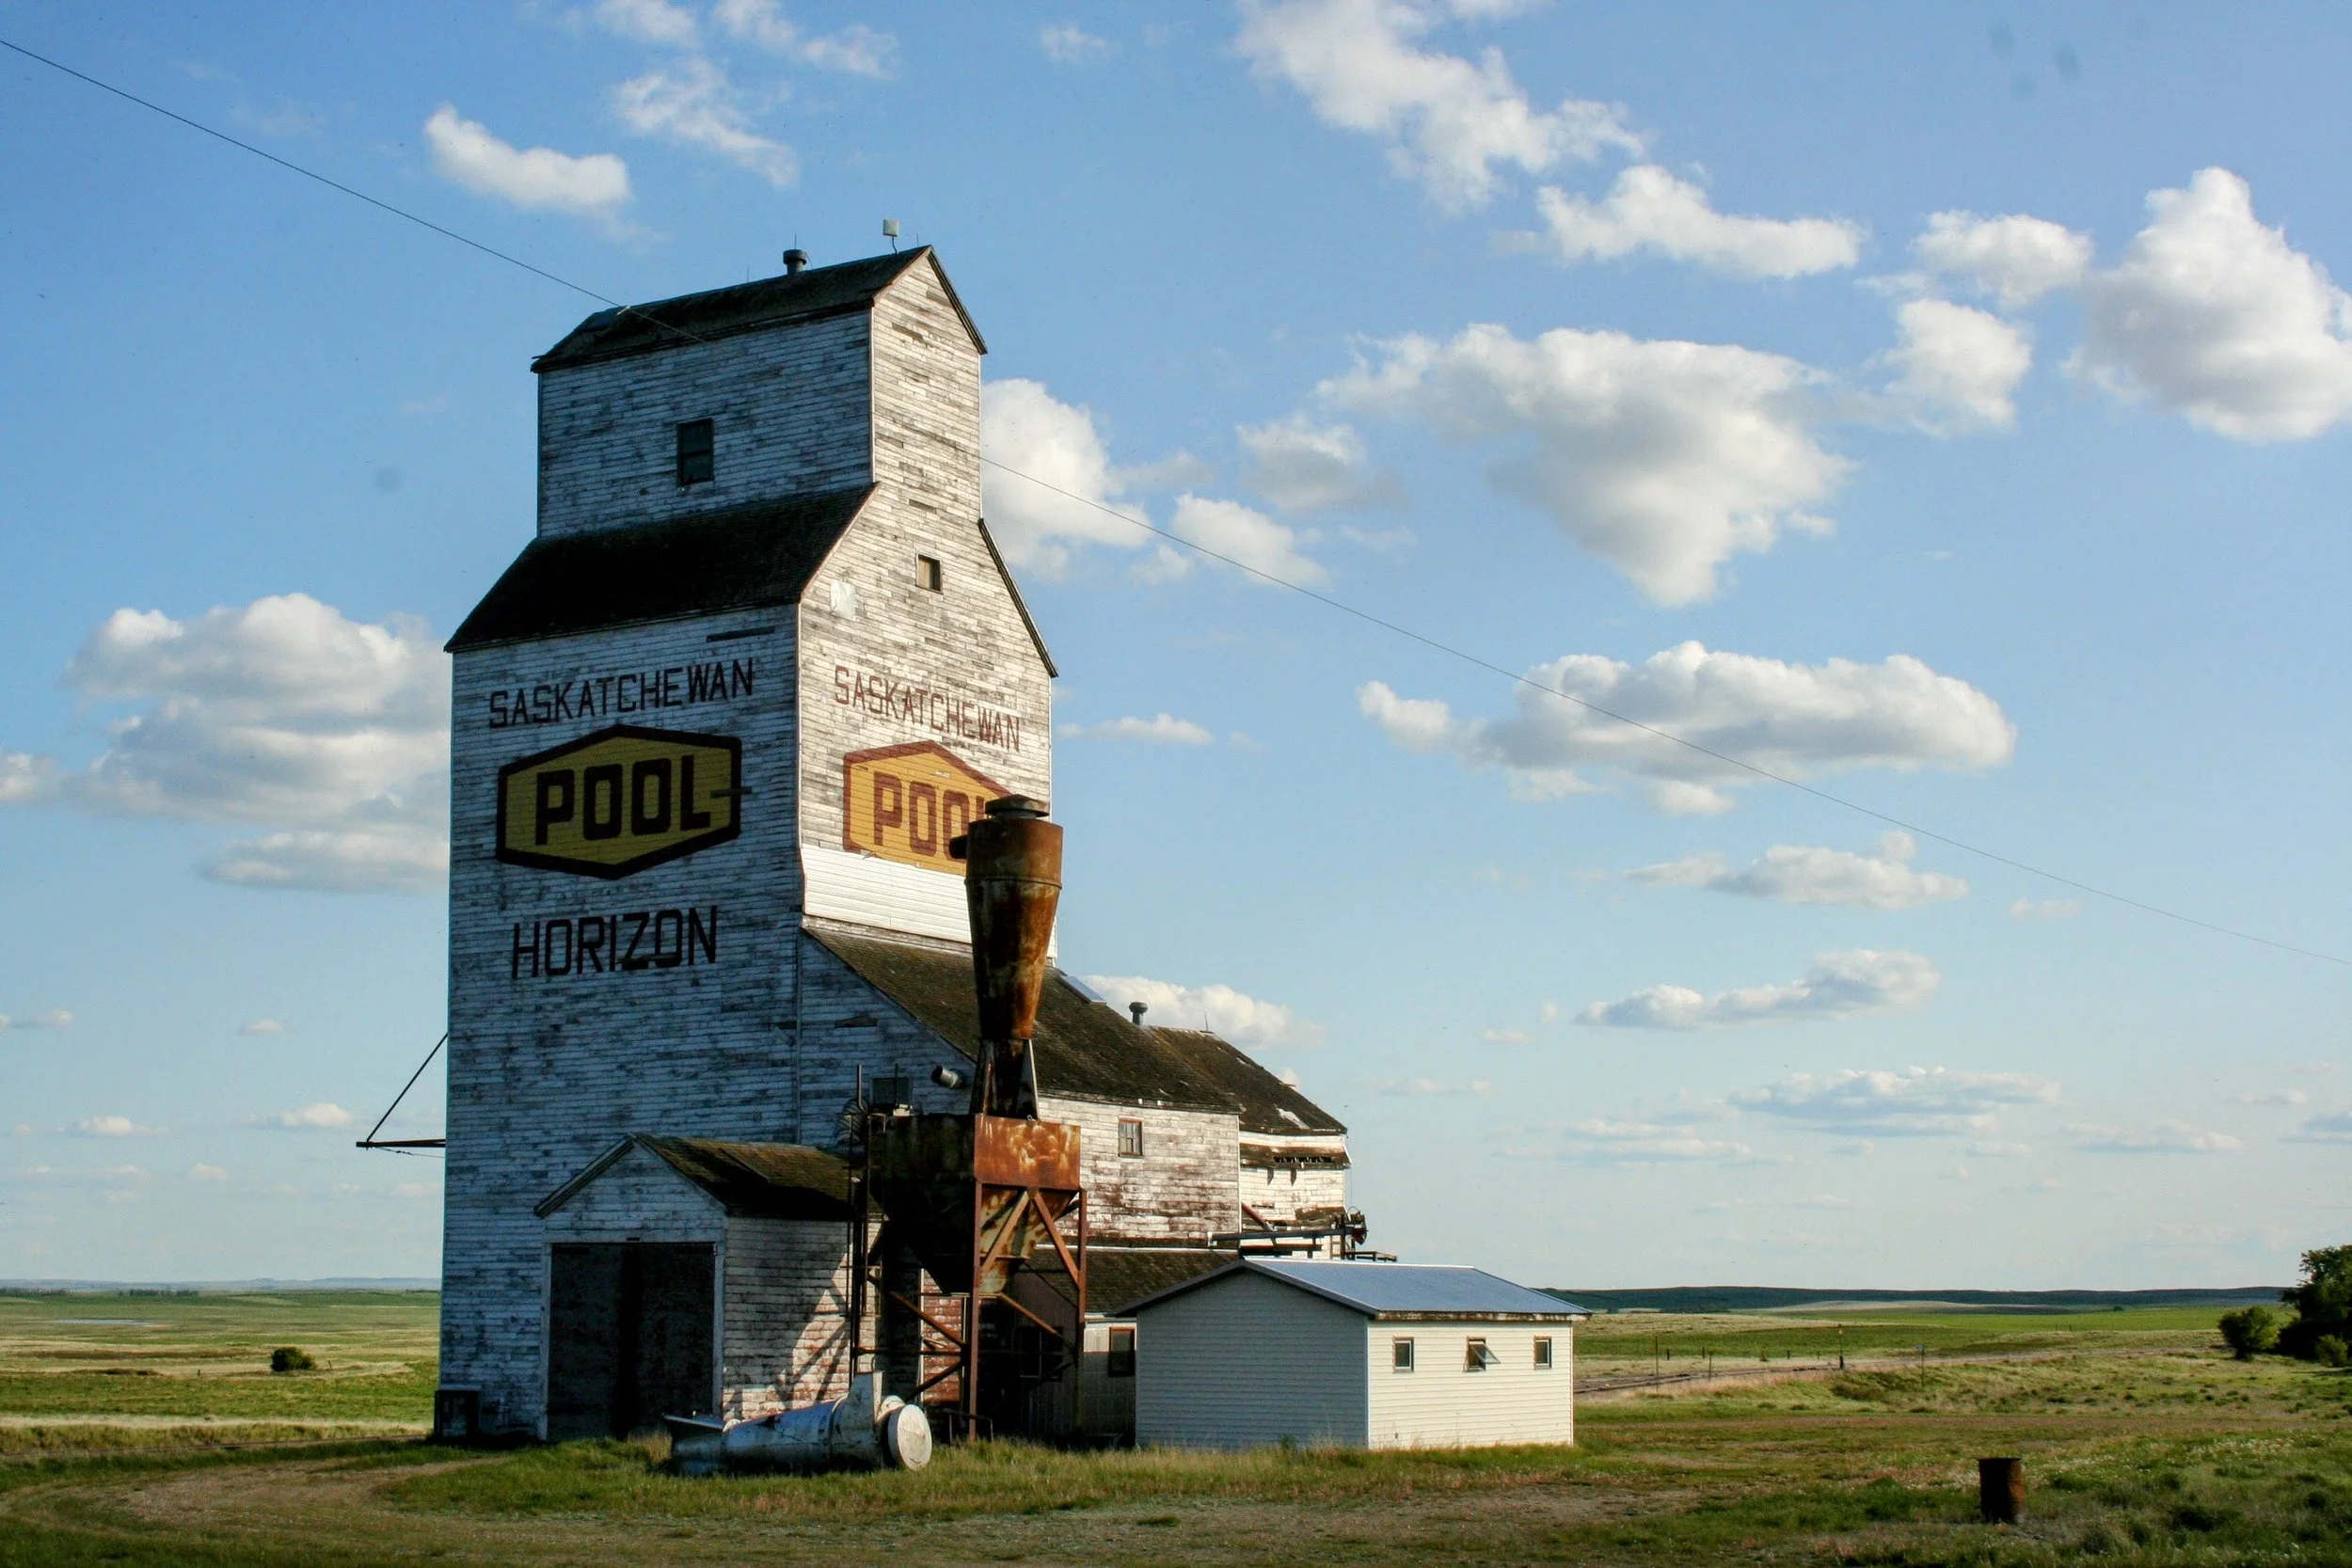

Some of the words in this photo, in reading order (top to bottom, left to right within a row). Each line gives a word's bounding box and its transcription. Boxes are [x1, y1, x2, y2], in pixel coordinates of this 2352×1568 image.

[489, 657, 755, 728] SASKATCHEWAN
[834, 664, 1020, 752] SASKATCHEWAN
[535, 754, 711, 846] POOL
[873, 771, 985, 863] POO
[512, 905, 718, 979] HORIZON
